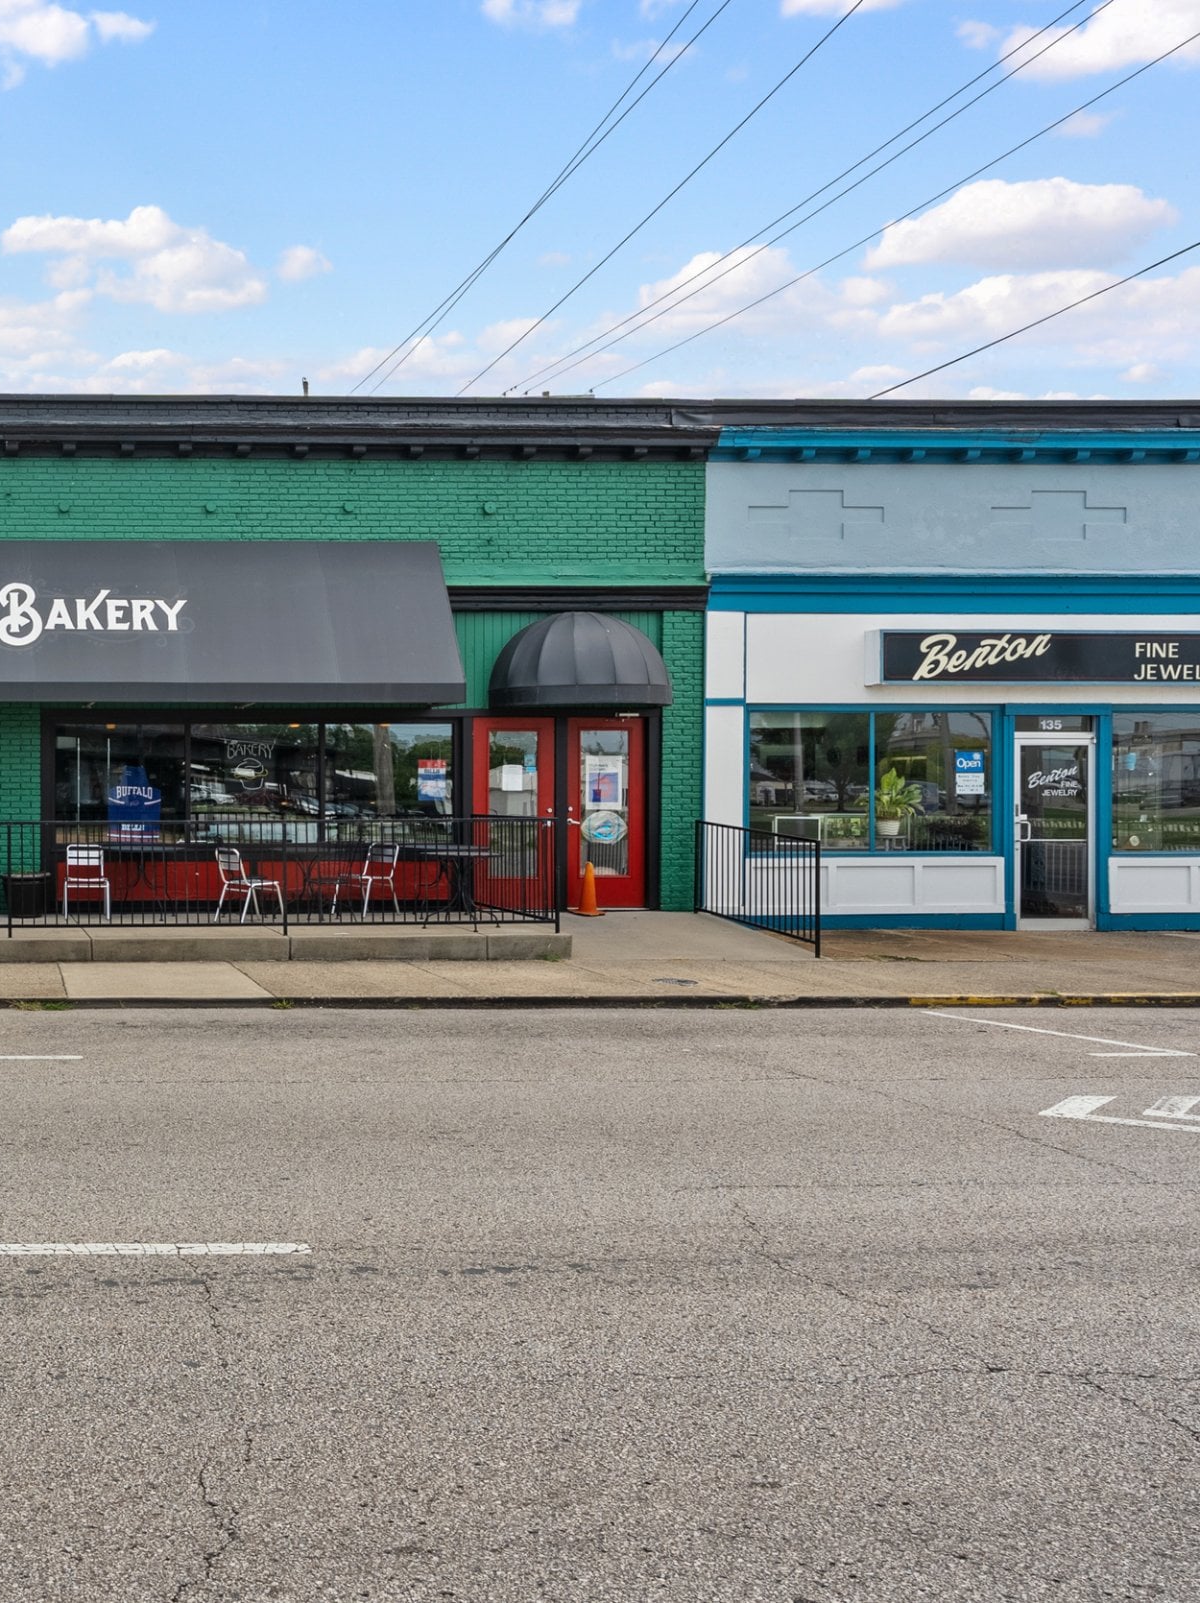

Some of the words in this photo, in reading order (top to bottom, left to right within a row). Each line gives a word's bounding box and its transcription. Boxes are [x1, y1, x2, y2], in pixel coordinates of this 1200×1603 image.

[912, 633, 1052, 682] Benton
[1135, 642, 1179, 658] FINE
[1133, 664, 1200, 680] JEWEL
[1041, 720, 1062, 730] 135
[227, 739, 275, 759] BAKERY
[956, 757, 981, 769] Open
[1028, 766, 1077, 788] Benton
[116, 785, 153, 799] BUFFALO
[1041, 789, 1078, 797] JEWELRY
